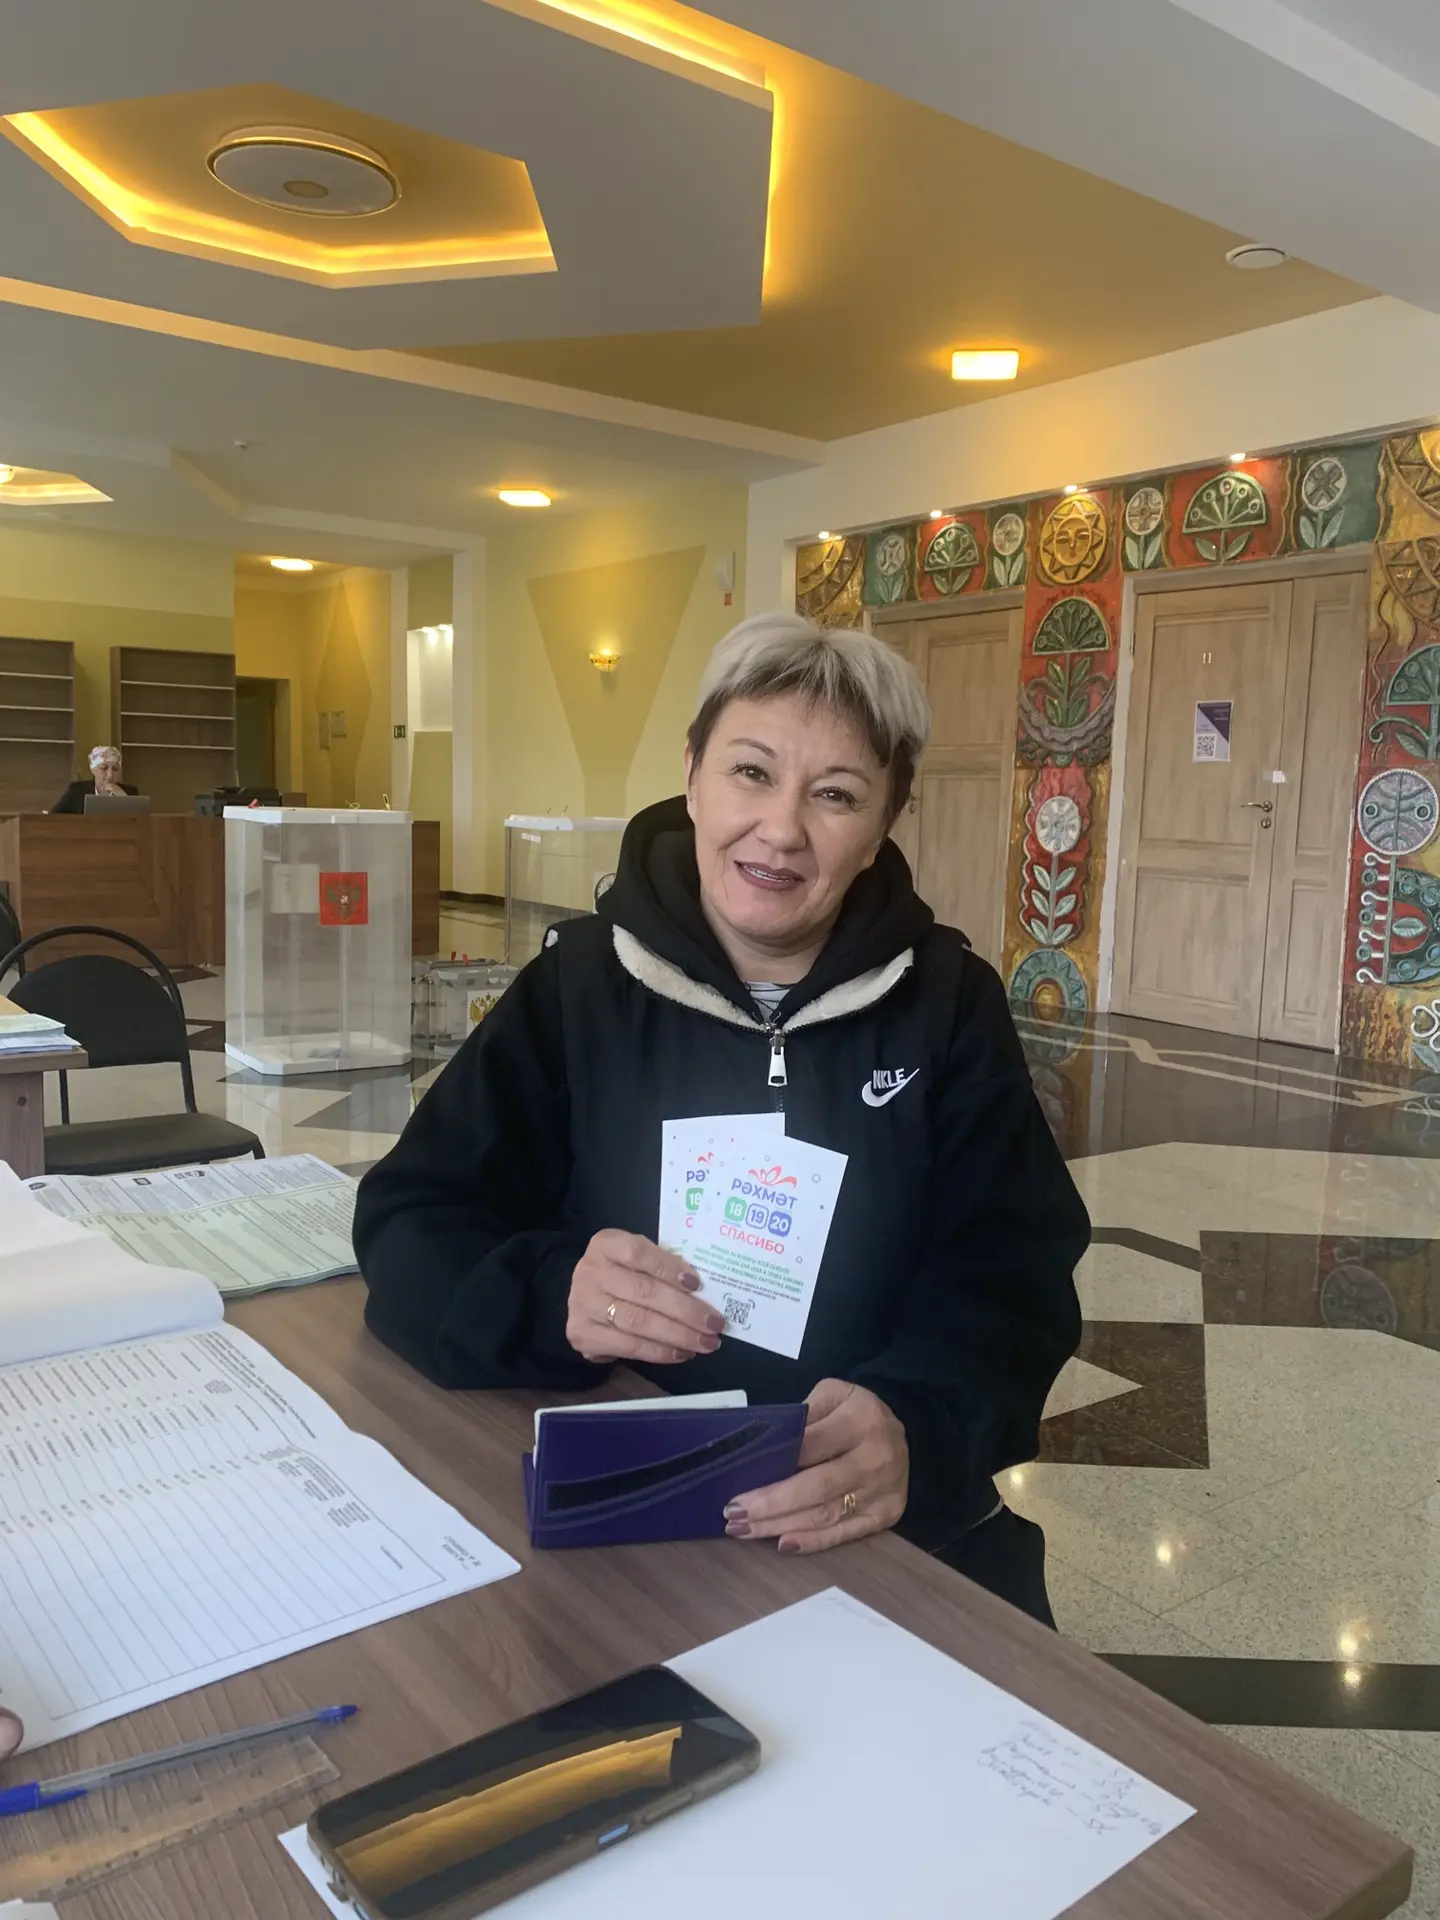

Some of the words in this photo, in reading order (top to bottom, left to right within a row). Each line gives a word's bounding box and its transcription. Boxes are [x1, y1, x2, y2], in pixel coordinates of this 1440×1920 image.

[731, 1178, 798, 1209] РӘХМӘТ
[729, 1201, 743, 1217] 18
[750, 1209, 765, 1224] 19
[770, 1216, 790, 1233] 20
[719, 1224, 785, 1255] СПАСИБО
